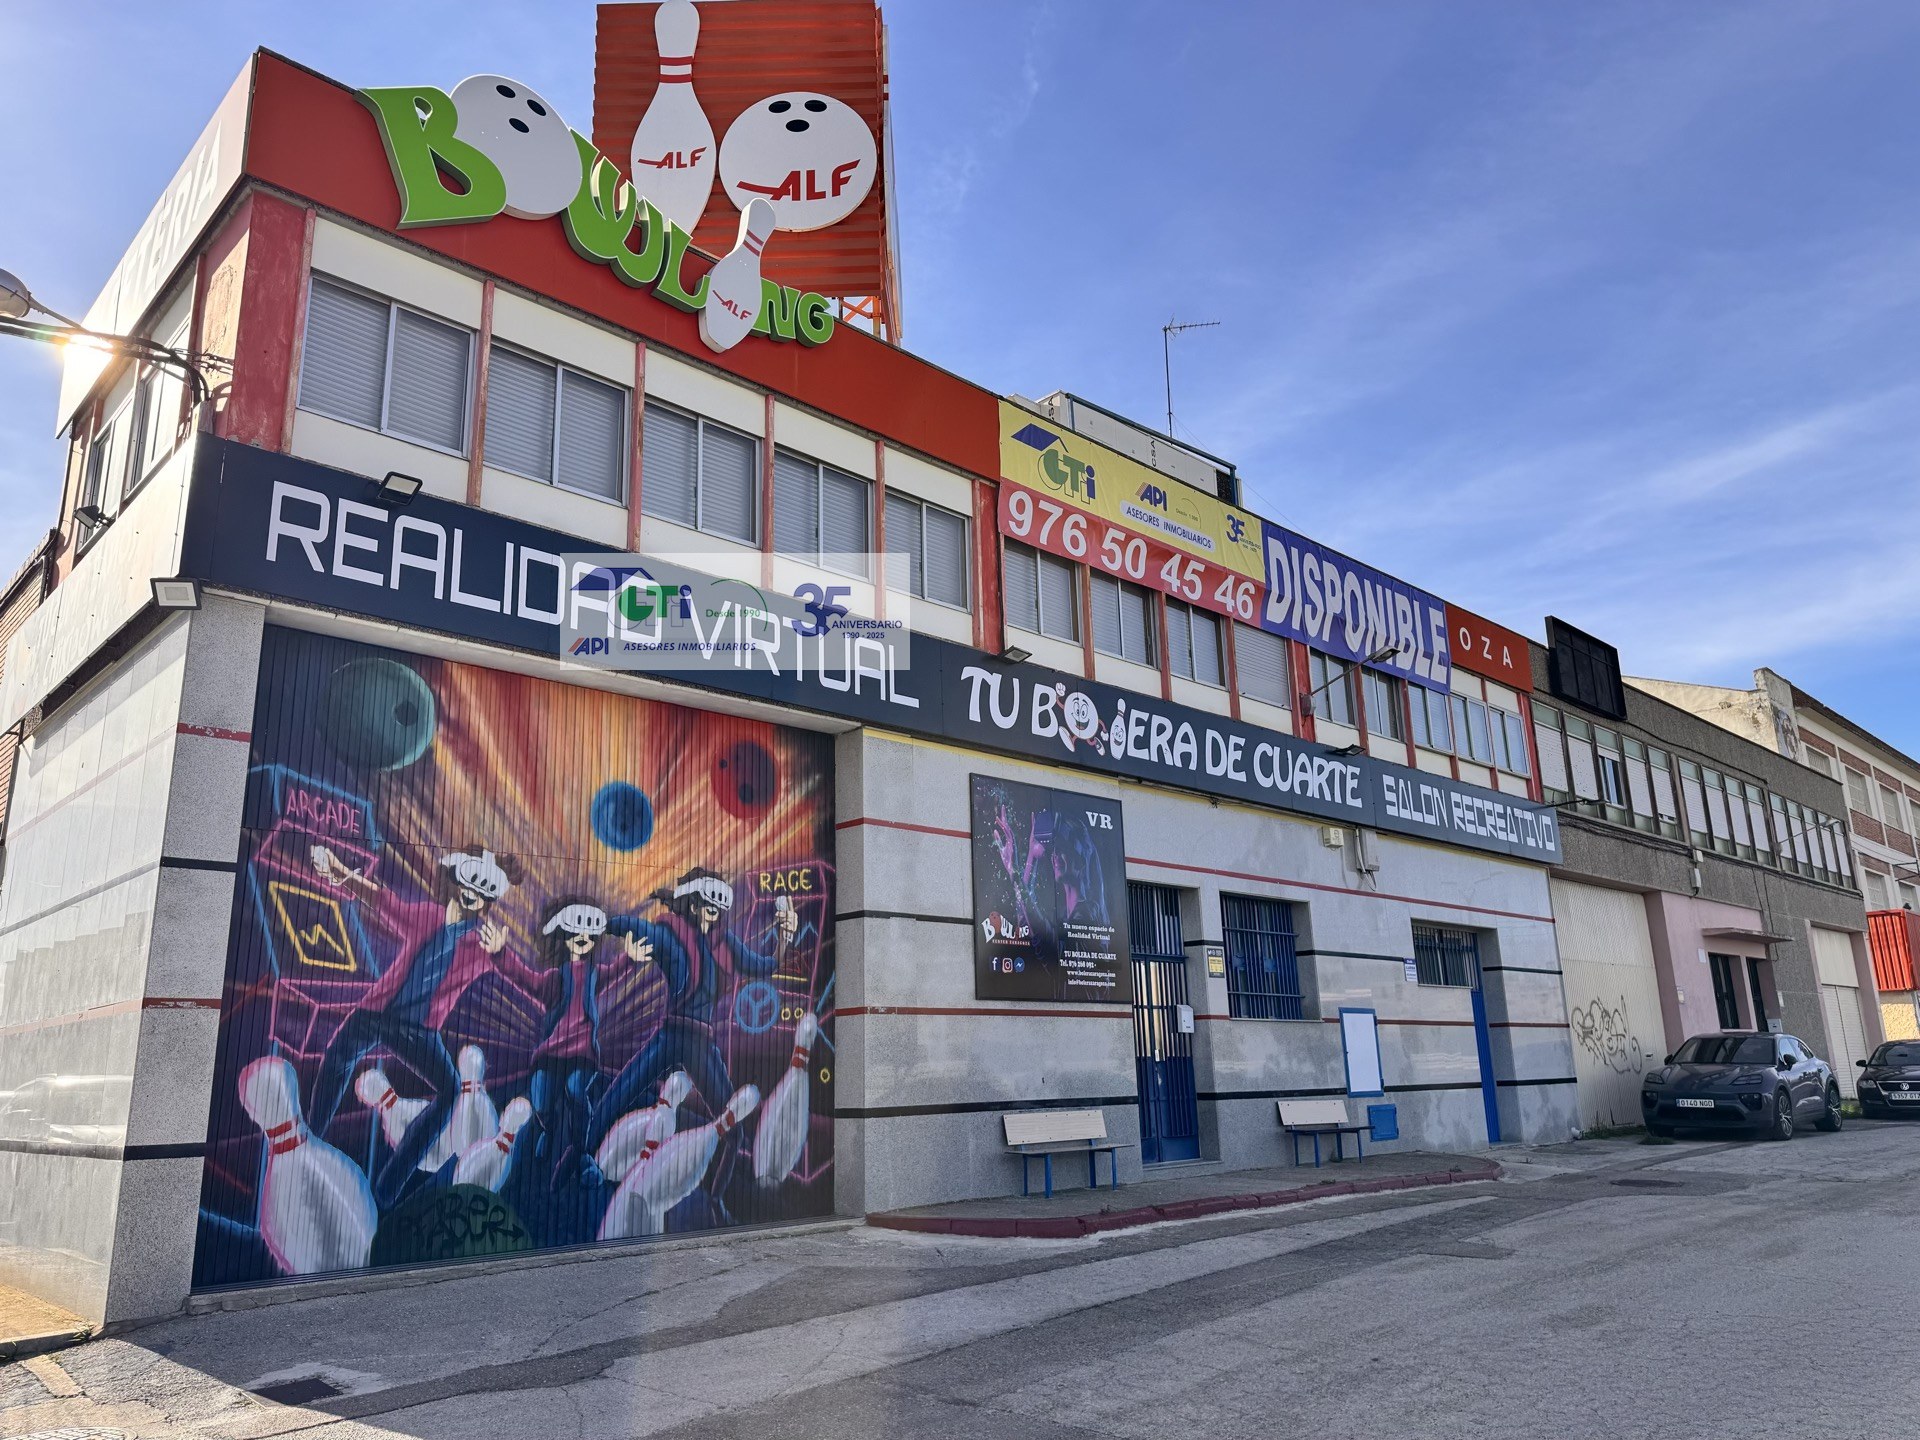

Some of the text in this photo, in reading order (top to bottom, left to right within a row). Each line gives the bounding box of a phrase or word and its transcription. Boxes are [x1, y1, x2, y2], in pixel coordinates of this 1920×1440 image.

[638, 146, 707, 169] ALF
[736, 158, 861, 200] ALF
[712, 289, 752, 320] ALF
[1126, 506, 1160, 528] ASESORES
[1163, 522, 1212, 549] INMOBILIARIOS
[1008, 490, 1256, 620] 976 50 45 46
[266, 480, 662, 646] REALIDAD
[684, 586, 920, 709] VIRTUAL
[1266, 536, 1448, 685] DISPONIBLE
[961, 666, 1020, 730] TU
[1205, 728, 1247, 782] DE
[1253, 742, 1363, 809] CUARTE
[286, 788, 361, 834] ARCADE
[1086, 811, 1113, 830] VR
[1382, 774, 1556, 851] SALON RECREATIVO
[1067, 931, 1091, 939] Realidad
